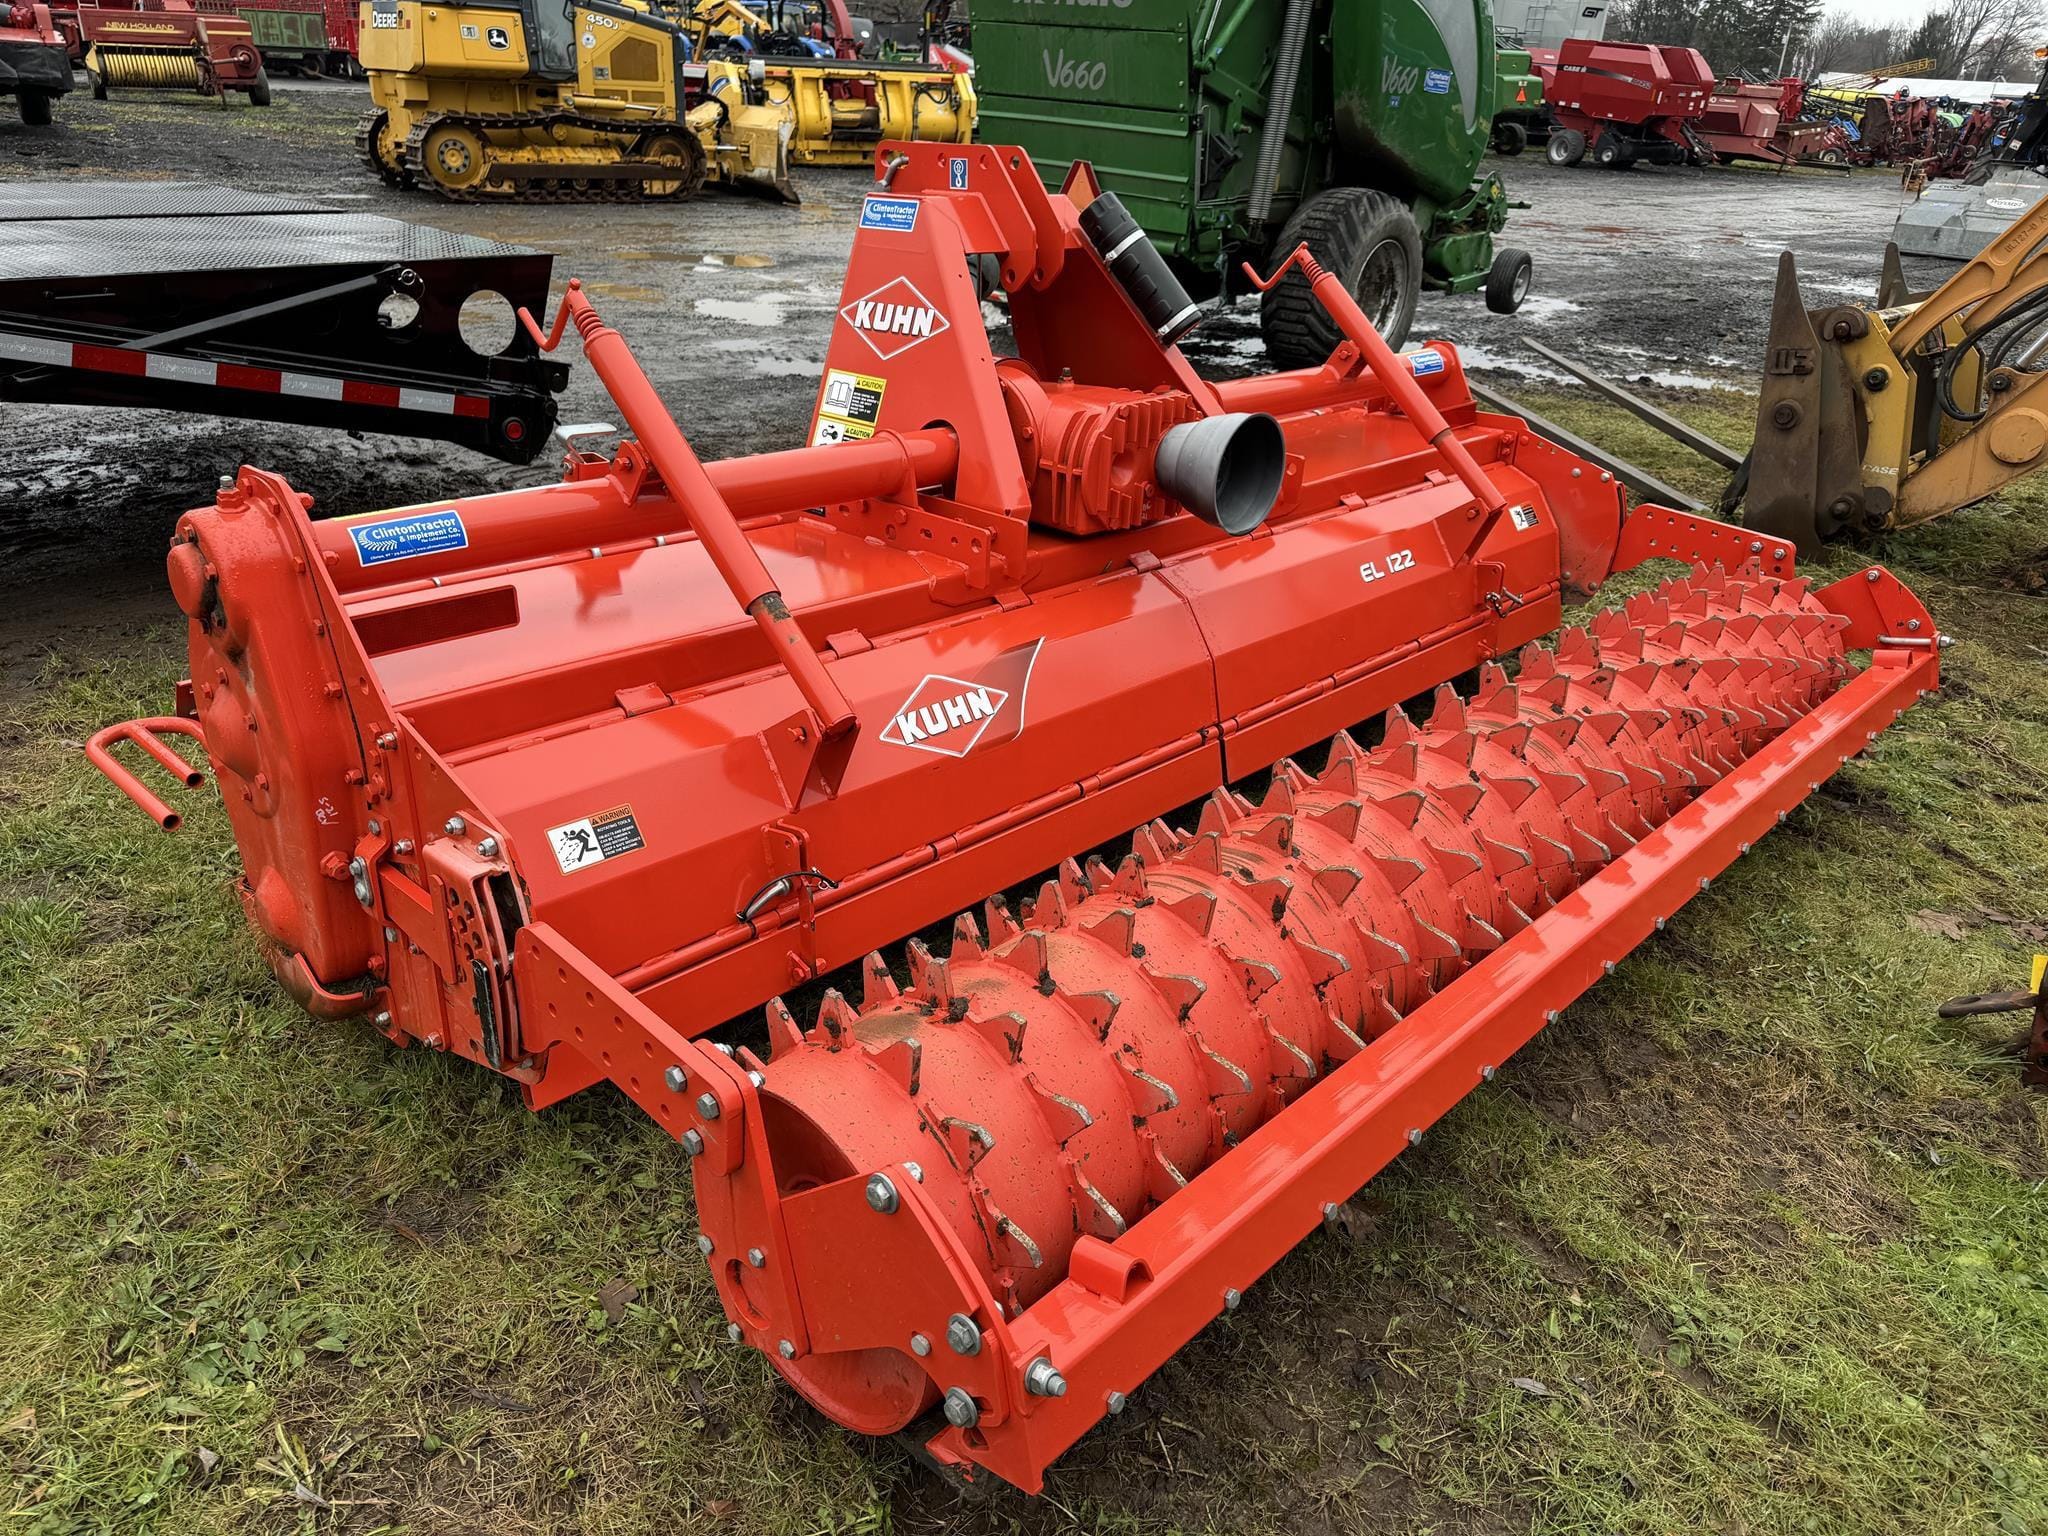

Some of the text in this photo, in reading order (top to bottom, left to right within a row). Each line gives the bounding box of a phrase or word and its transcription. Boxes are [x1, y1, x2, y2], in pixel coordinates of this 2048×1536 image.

[105, 21, 175, 31] NEW HOLLAND
[372, 11, 398, 28] DEERE
[586, 13, 619, 30] 450J
[1043, 48, 1107, 90] V660
[1381, 54, 1419, 94] V660
[855, 300, 935, 337] KUHN
[861, 380, 884, 390] CAUTION
[849, 428, 871, 438] CAUTION
[371, 518, 456, 540] ClintonTractor
[399, 535, 406, 543] &
[406, 528, 448, 542] Implement
[1360, 549, 1416, 583] EL 122
[895, 686, 995, 745] KUHN
[599, 807, 630, 823] WARNING
